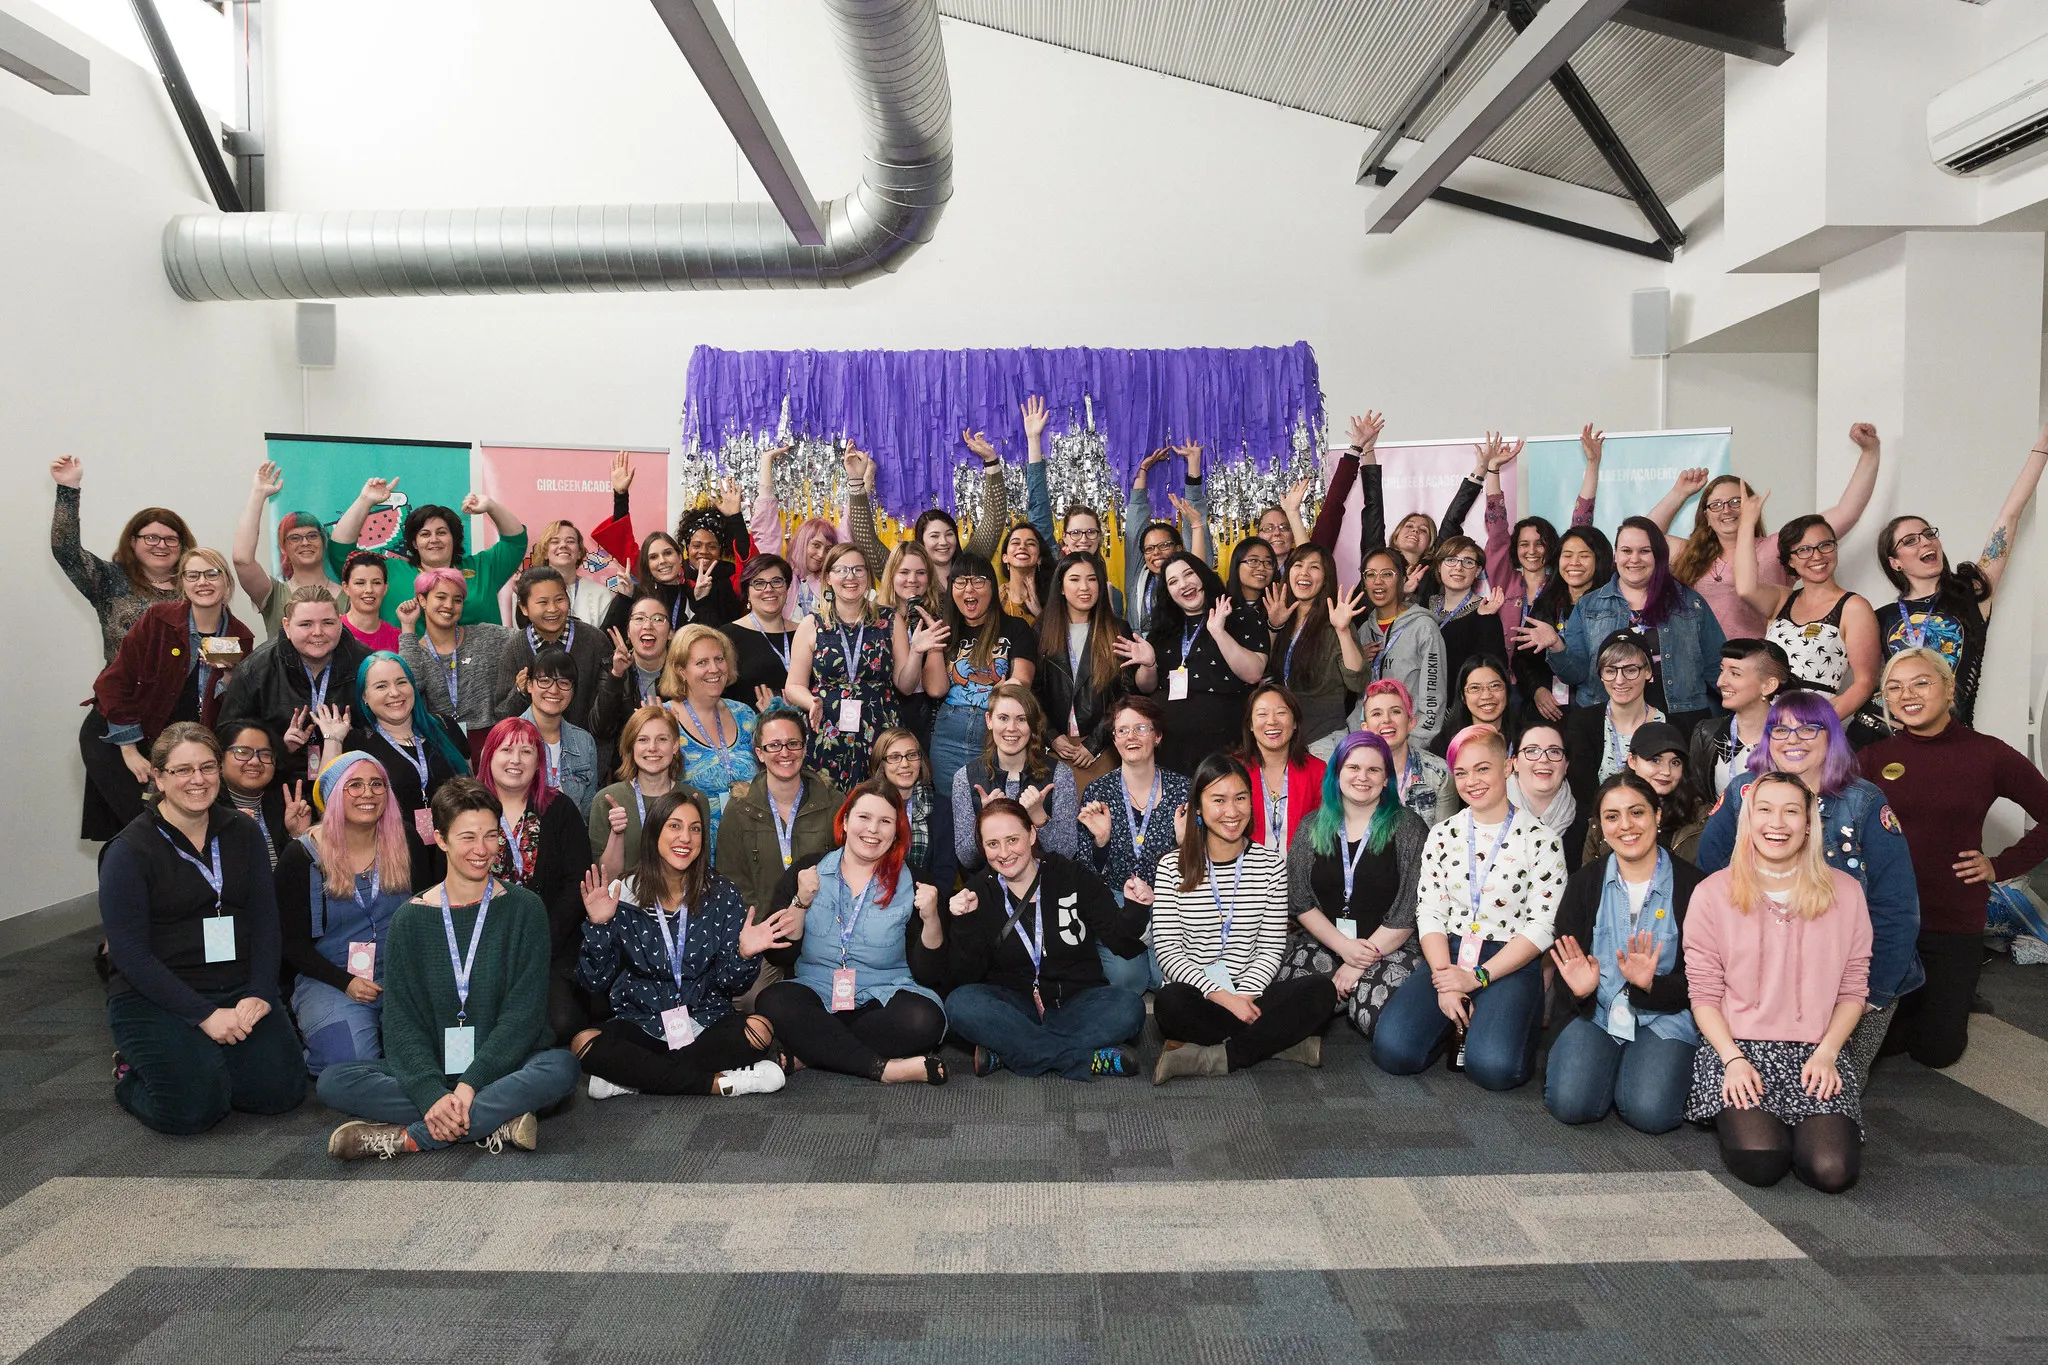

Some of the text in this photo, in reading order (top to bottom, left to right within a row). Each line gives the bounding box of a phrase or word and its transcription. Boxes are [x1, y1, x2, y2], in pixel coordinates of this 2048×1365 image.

[537, 478, 613, 493] GIRLGEEKACADE
[1383, 659, 1394, 669] AY
[1422, 653, 1438, 731] KEEP ON TRUCKIN
